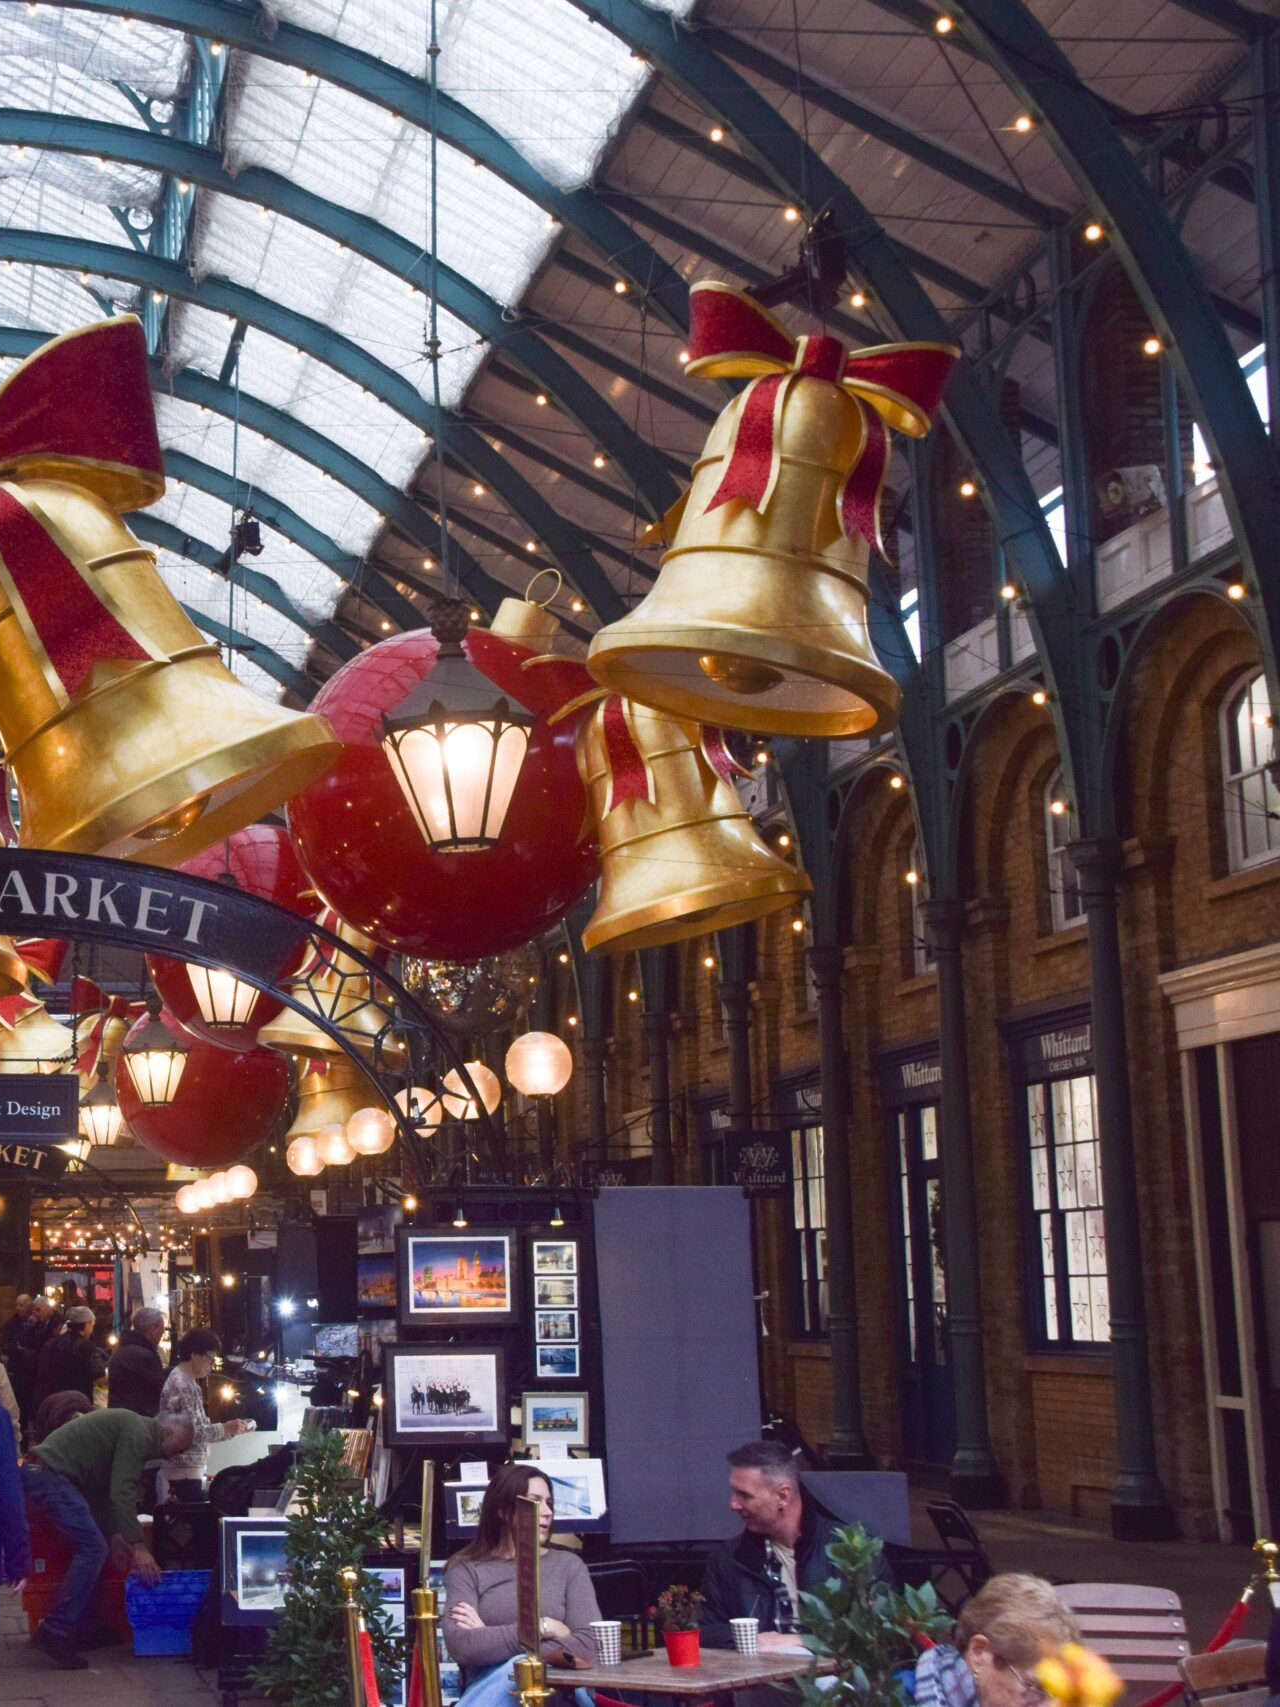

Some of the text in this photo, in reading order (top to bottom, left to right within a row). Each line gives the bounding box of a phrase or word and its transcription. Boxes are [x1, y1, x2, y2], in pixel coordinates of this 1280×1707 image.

[1041, 1024, 1091, 1060] Whittard
[7, 1101, 61, 1120] Design
[733, 1171, 786, 1183] Wittard
